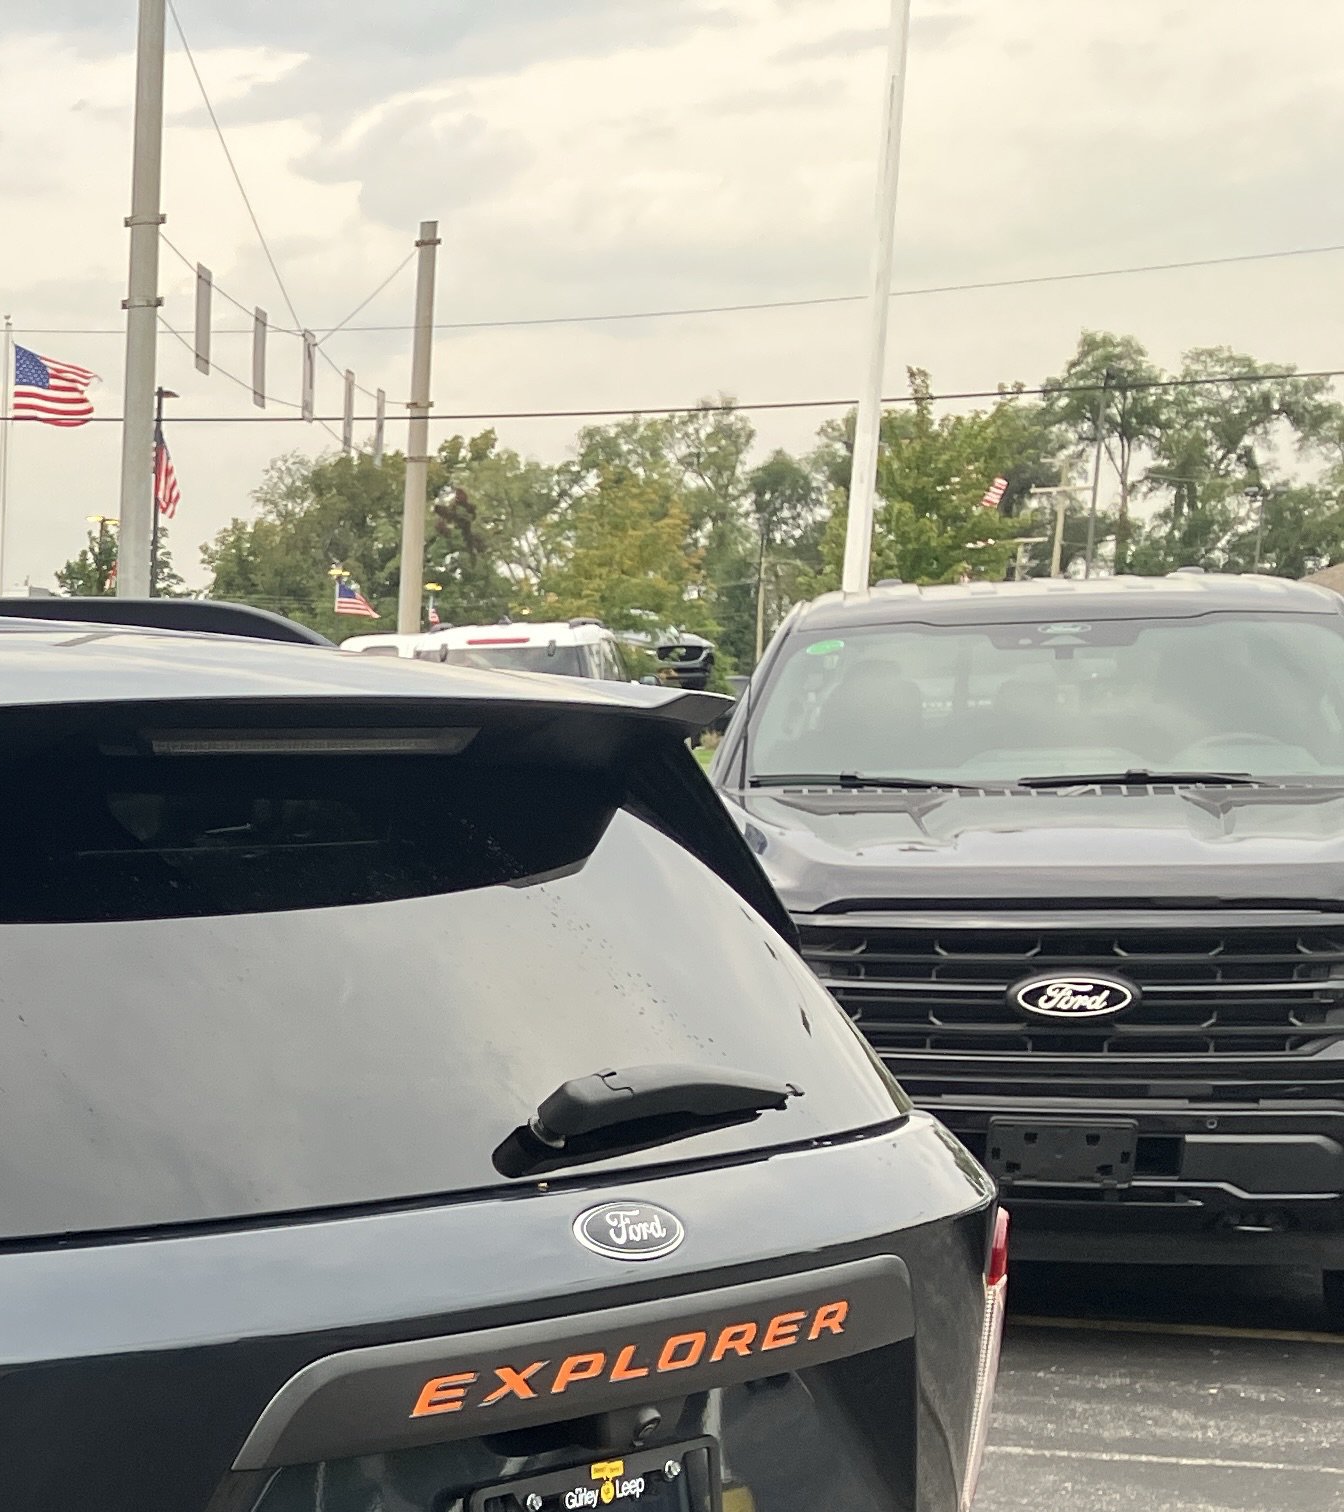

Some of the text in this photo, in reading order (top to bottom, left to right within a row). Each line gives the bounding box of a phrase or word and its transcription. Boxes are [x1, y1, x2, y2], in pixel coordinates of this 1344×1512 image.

[1037, 983, 1111, 1010] Ford
[605, 1209, 667, 1245] Ford
[410, 1300, 850, 1418] EXPLORER
[565, 1487, 599, 1509] Gurley
[615, 1477, 645, 1499] Leep
